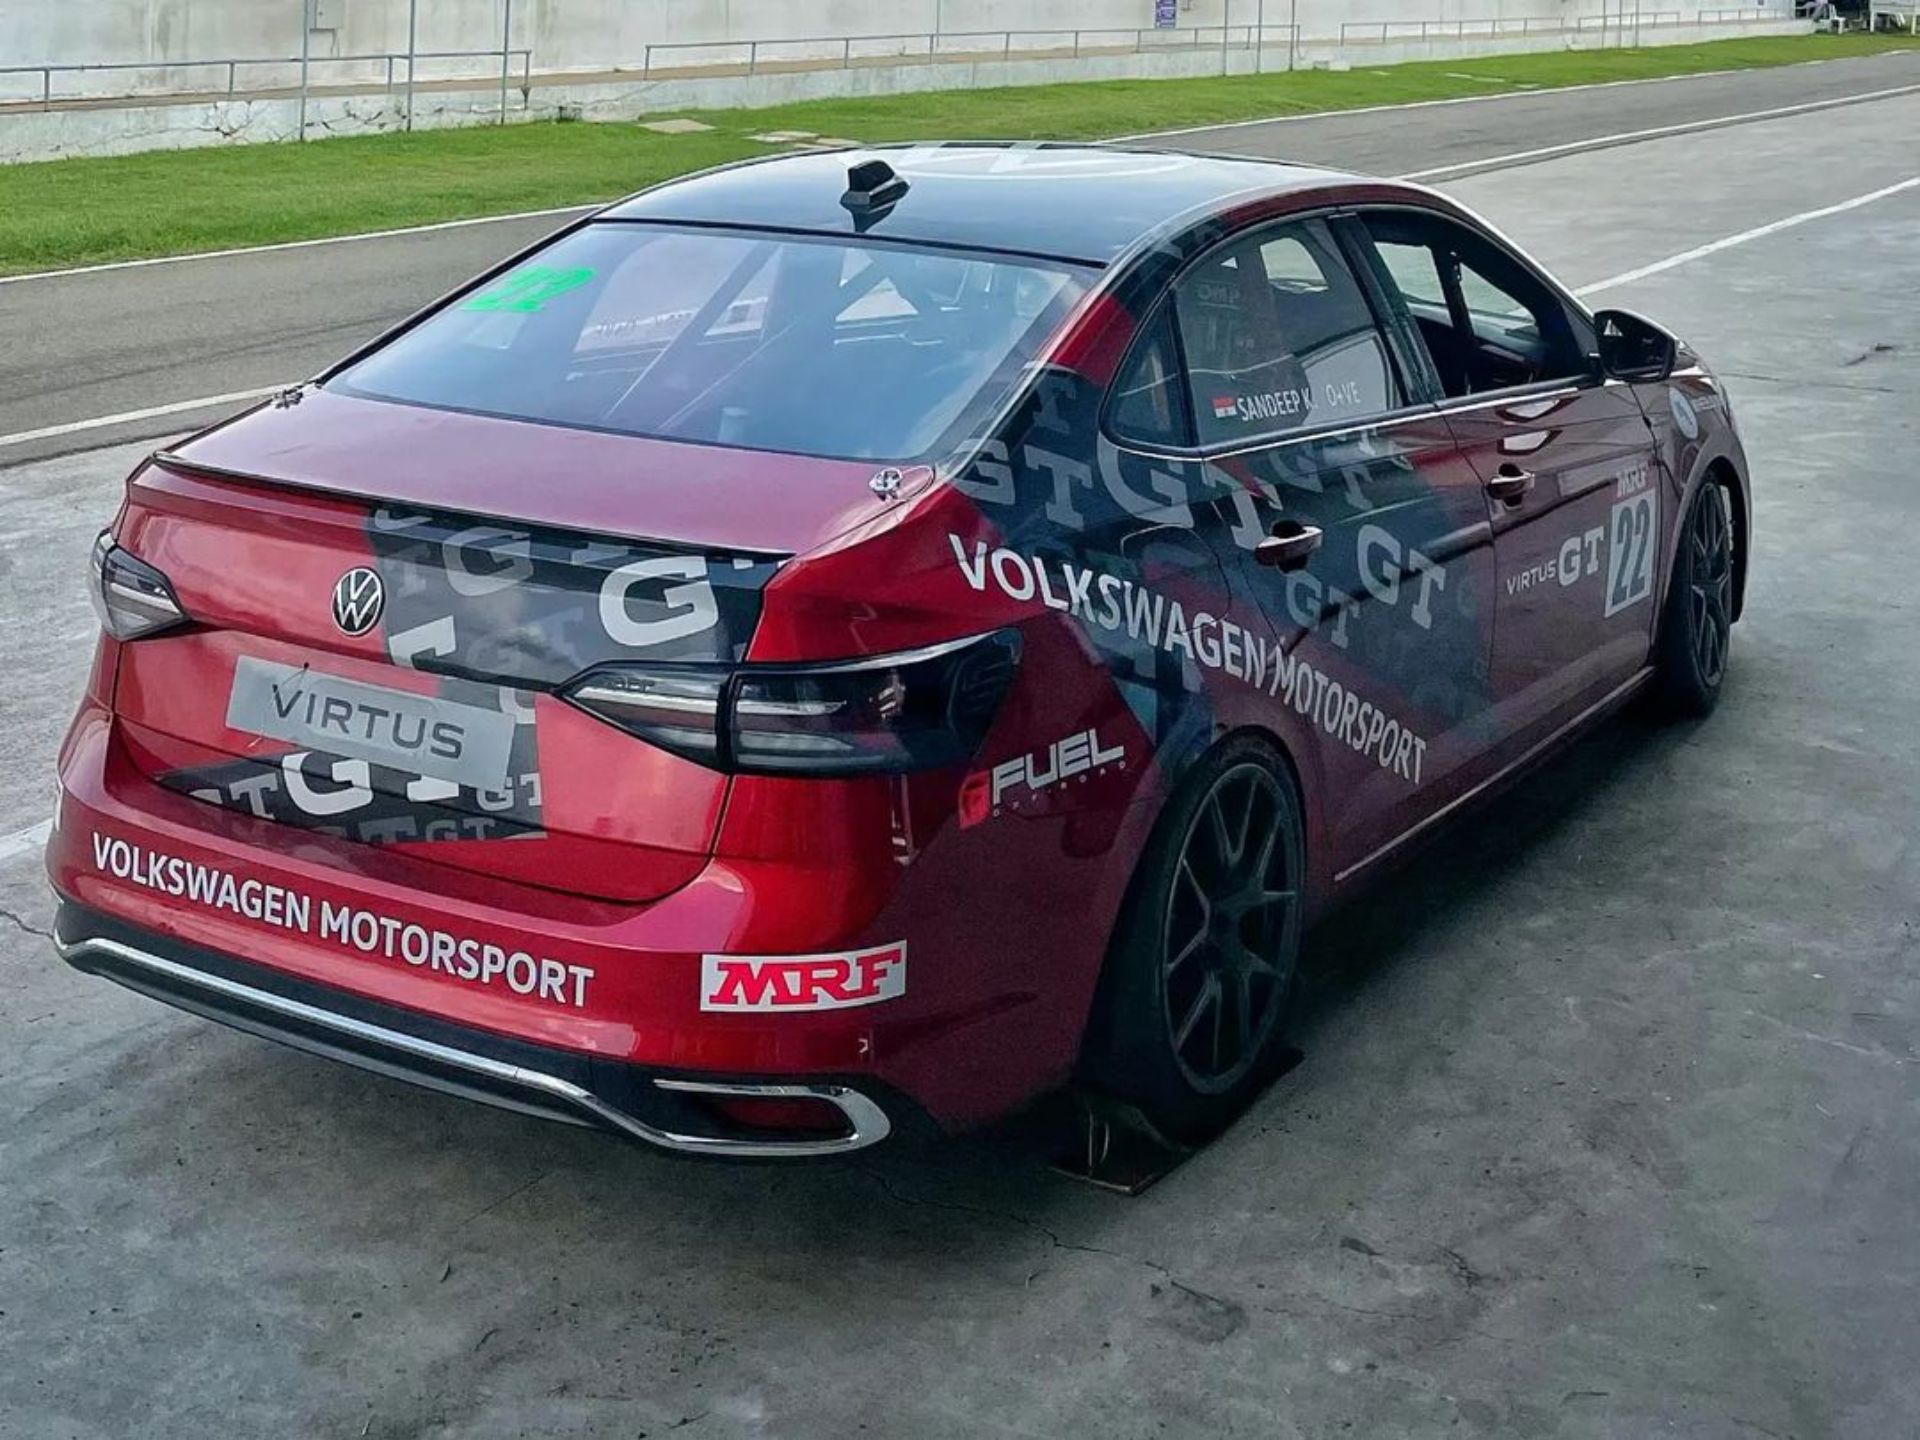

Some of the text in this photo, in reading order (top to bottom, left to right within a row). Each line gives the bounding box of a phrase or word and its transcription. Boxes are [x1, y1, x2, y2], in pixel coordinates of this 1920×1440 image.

[1236, 388, 1300, 422] SANDEEP
[1356, 523, 1448, 630] GT
[1506, 527, 1604, 595] VIRTUS GT
[1612, 499, 1650, 606] 22
[949, 533, 1428, 785] VOLKSWAGEN MOTORSPORT
[271, 683, 466, 760] VIRTUS
[92, 831, 595, 1008] VOLKSWAGEN MOTORSPORT
[708, 947, 903, 1006] MRF
